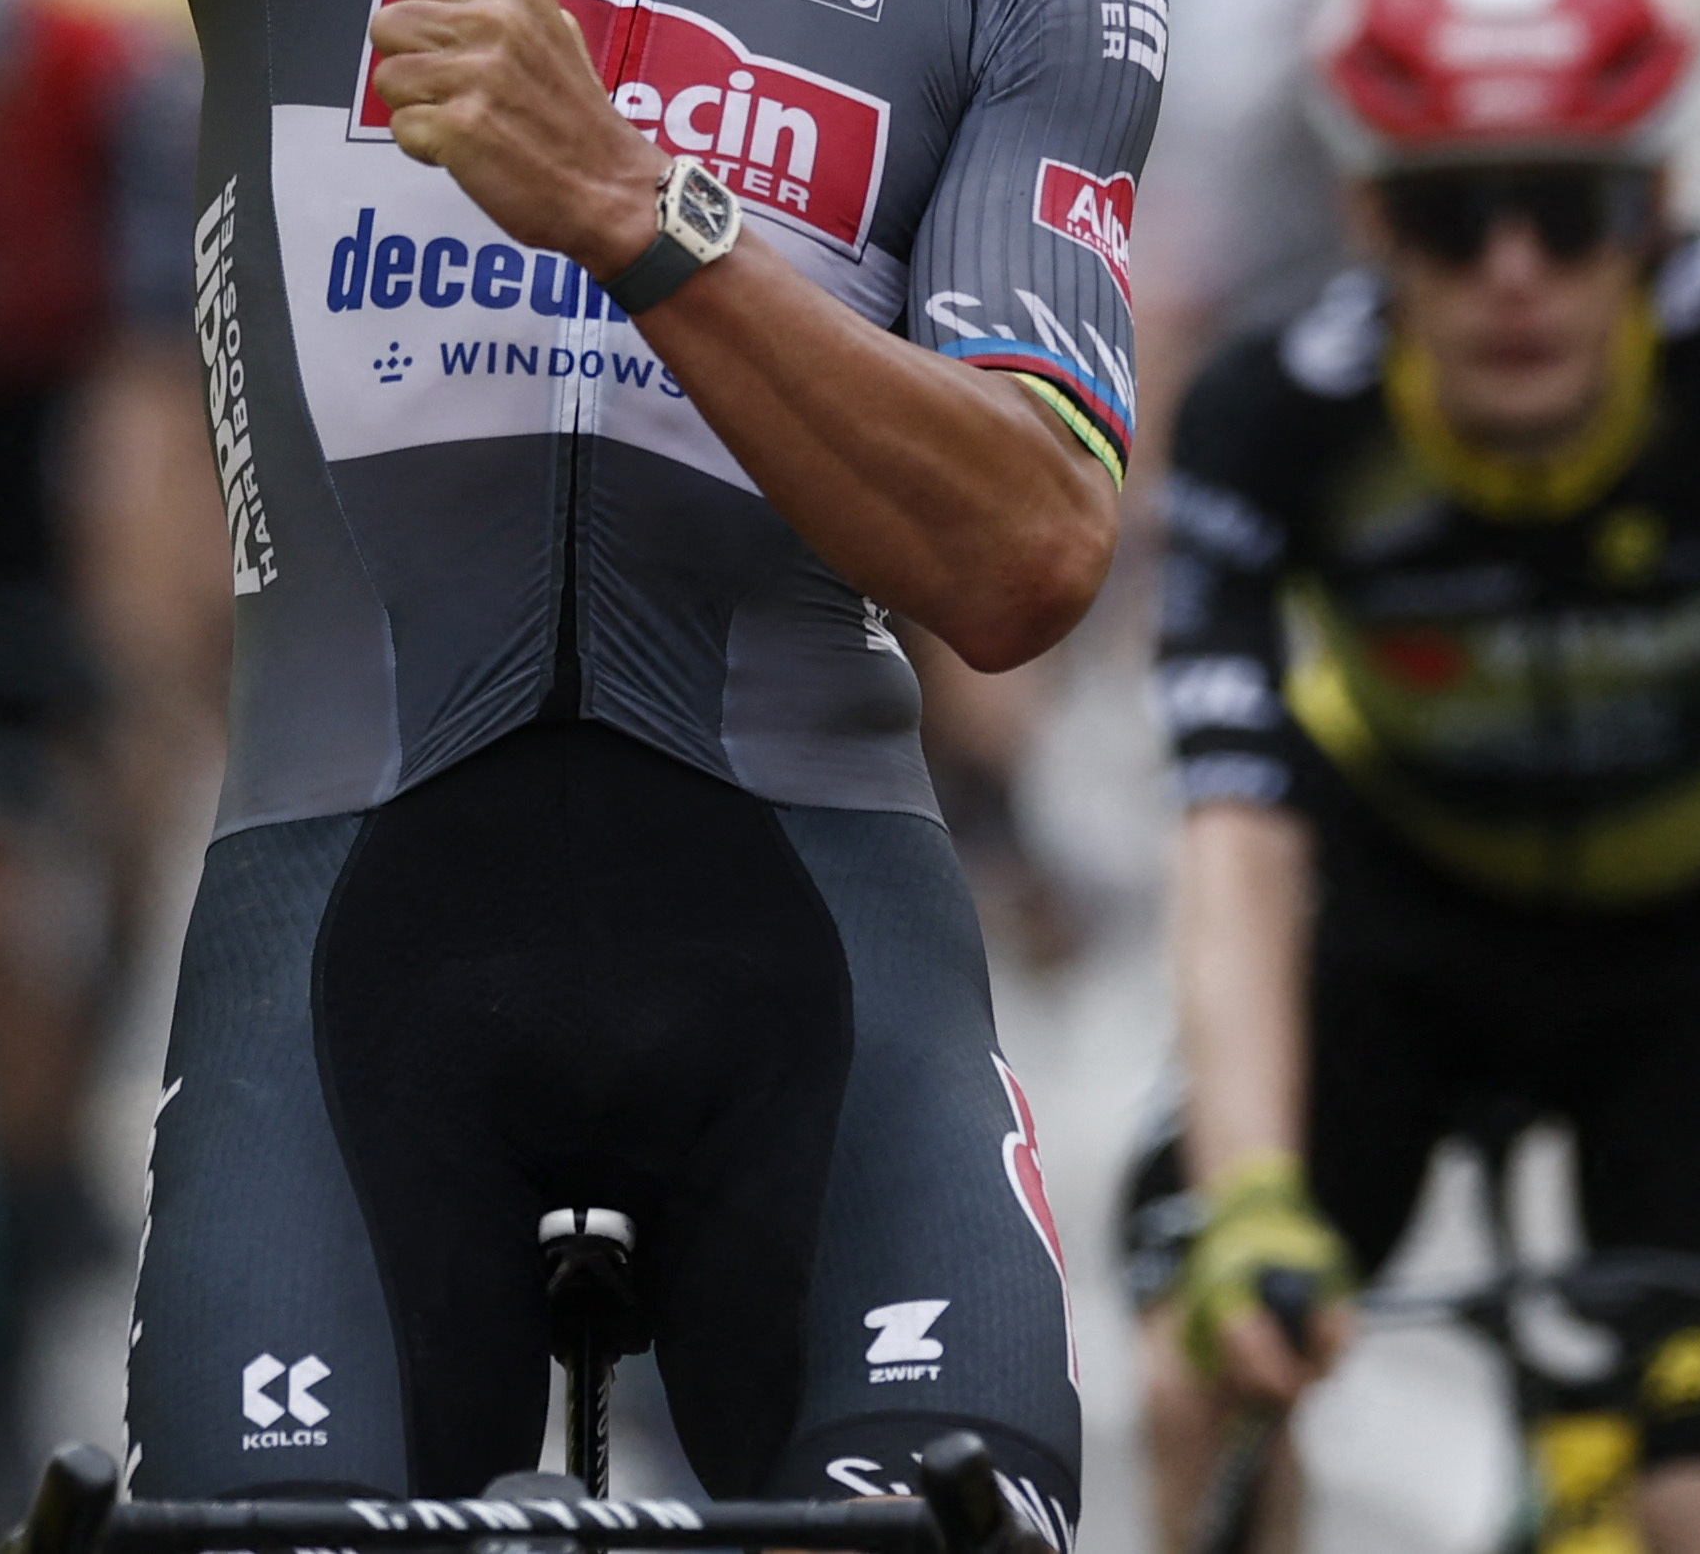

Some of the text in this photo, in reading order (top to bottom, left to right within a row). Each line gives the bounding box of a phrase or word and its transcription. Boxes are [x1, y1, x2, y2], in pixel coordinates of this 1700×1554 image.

[612, 70, 819, 184] ecin
[193, 193, 261, 597] Alpecin
[221, 174, 279, 586] HAIR BOOSTER
[440, 341, 686, 399] WINDOWS
[869, 1365, 941, 1384] ZWIFT
